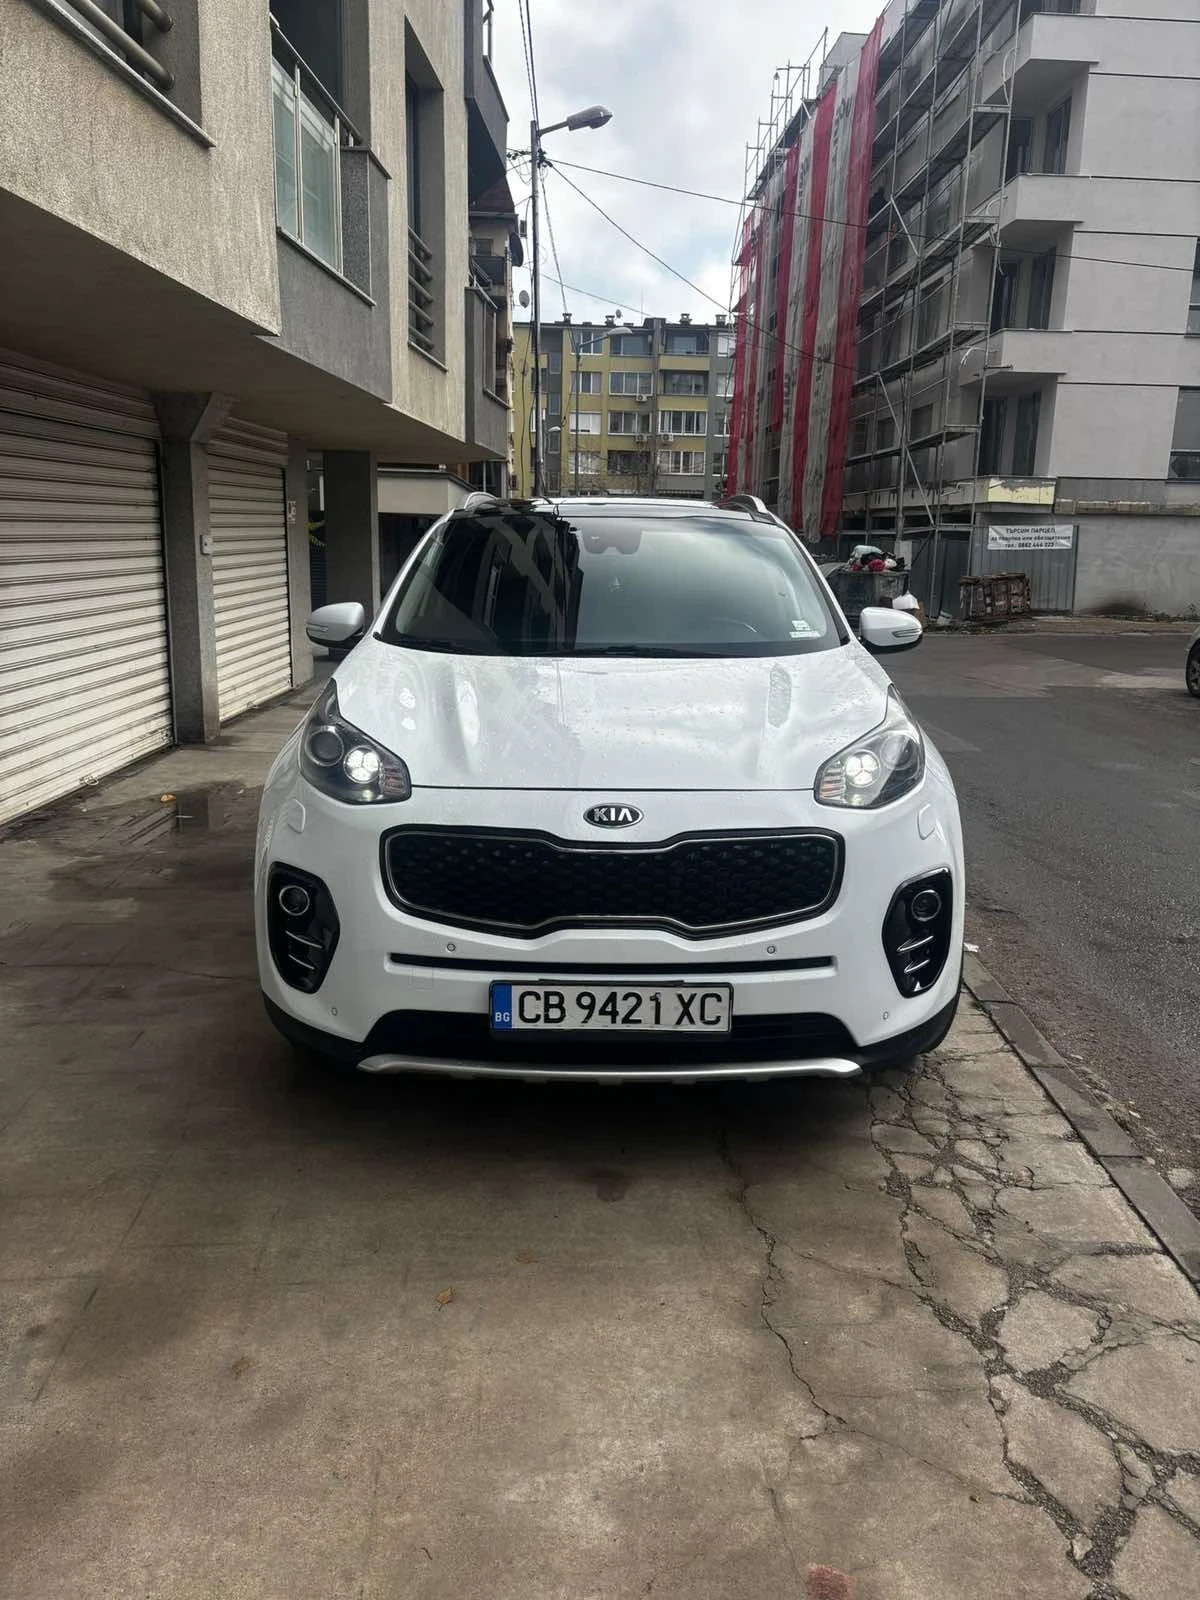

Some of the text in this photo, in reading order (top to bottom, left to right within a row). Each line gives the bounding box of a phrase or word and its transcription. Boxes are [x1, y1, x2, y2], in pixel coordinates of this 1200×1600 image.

[593, 807, 633, 822] KIA
[518, 991, 723, 1025] CB 9421 XC
[494, 1011, 511, 1022] BG
